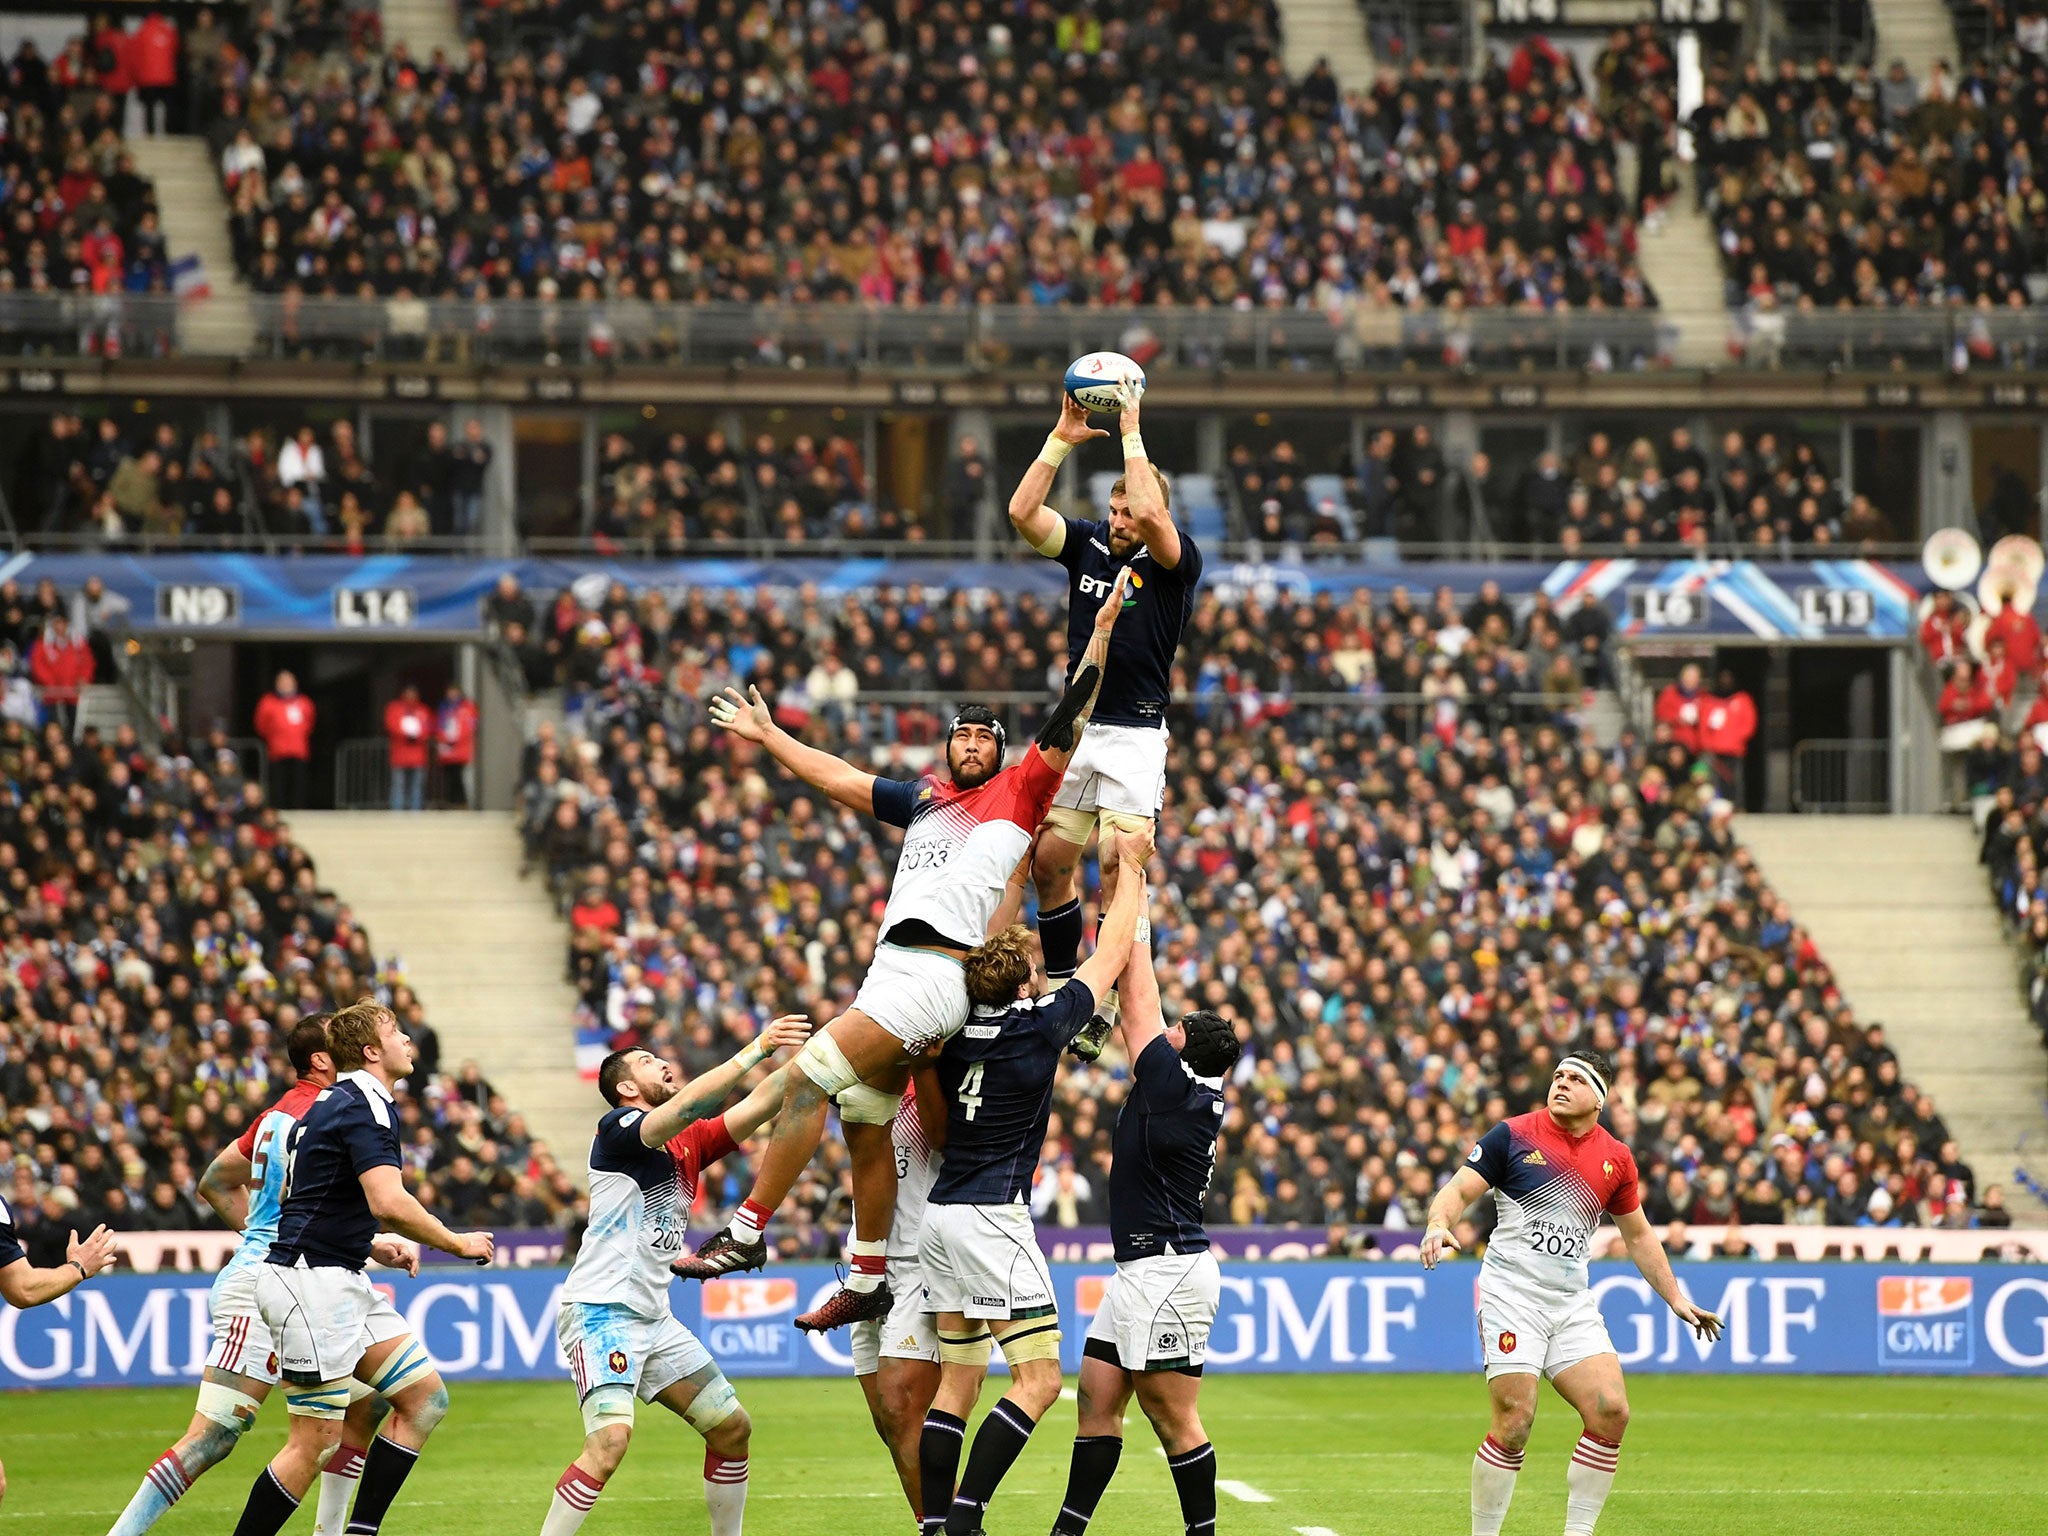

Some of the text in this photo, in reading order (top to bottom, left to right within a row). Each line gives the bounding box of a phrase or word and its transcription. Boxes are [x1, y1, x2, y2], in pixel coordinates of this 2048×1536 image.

[170, 586, 228, 625] N9
[1079, 574, 1112, 599] BT
[338, 589, 410, 627] L14
[1644, 589, 1693, 627] L6
[1801, 589, 1870, 627] L13
[900, 850, 947, 872] 2023
[958, 1060, 986, 1121] 4
[1014, 1292, 1046, 1302] macron
[1203, 1275, 1427, 1365] GMF
[1590, 1275, 1827, 1365] GMF
[1886, 1320, 1966, 1353] GMF
[710, 1323, 788, 1356] GMF
